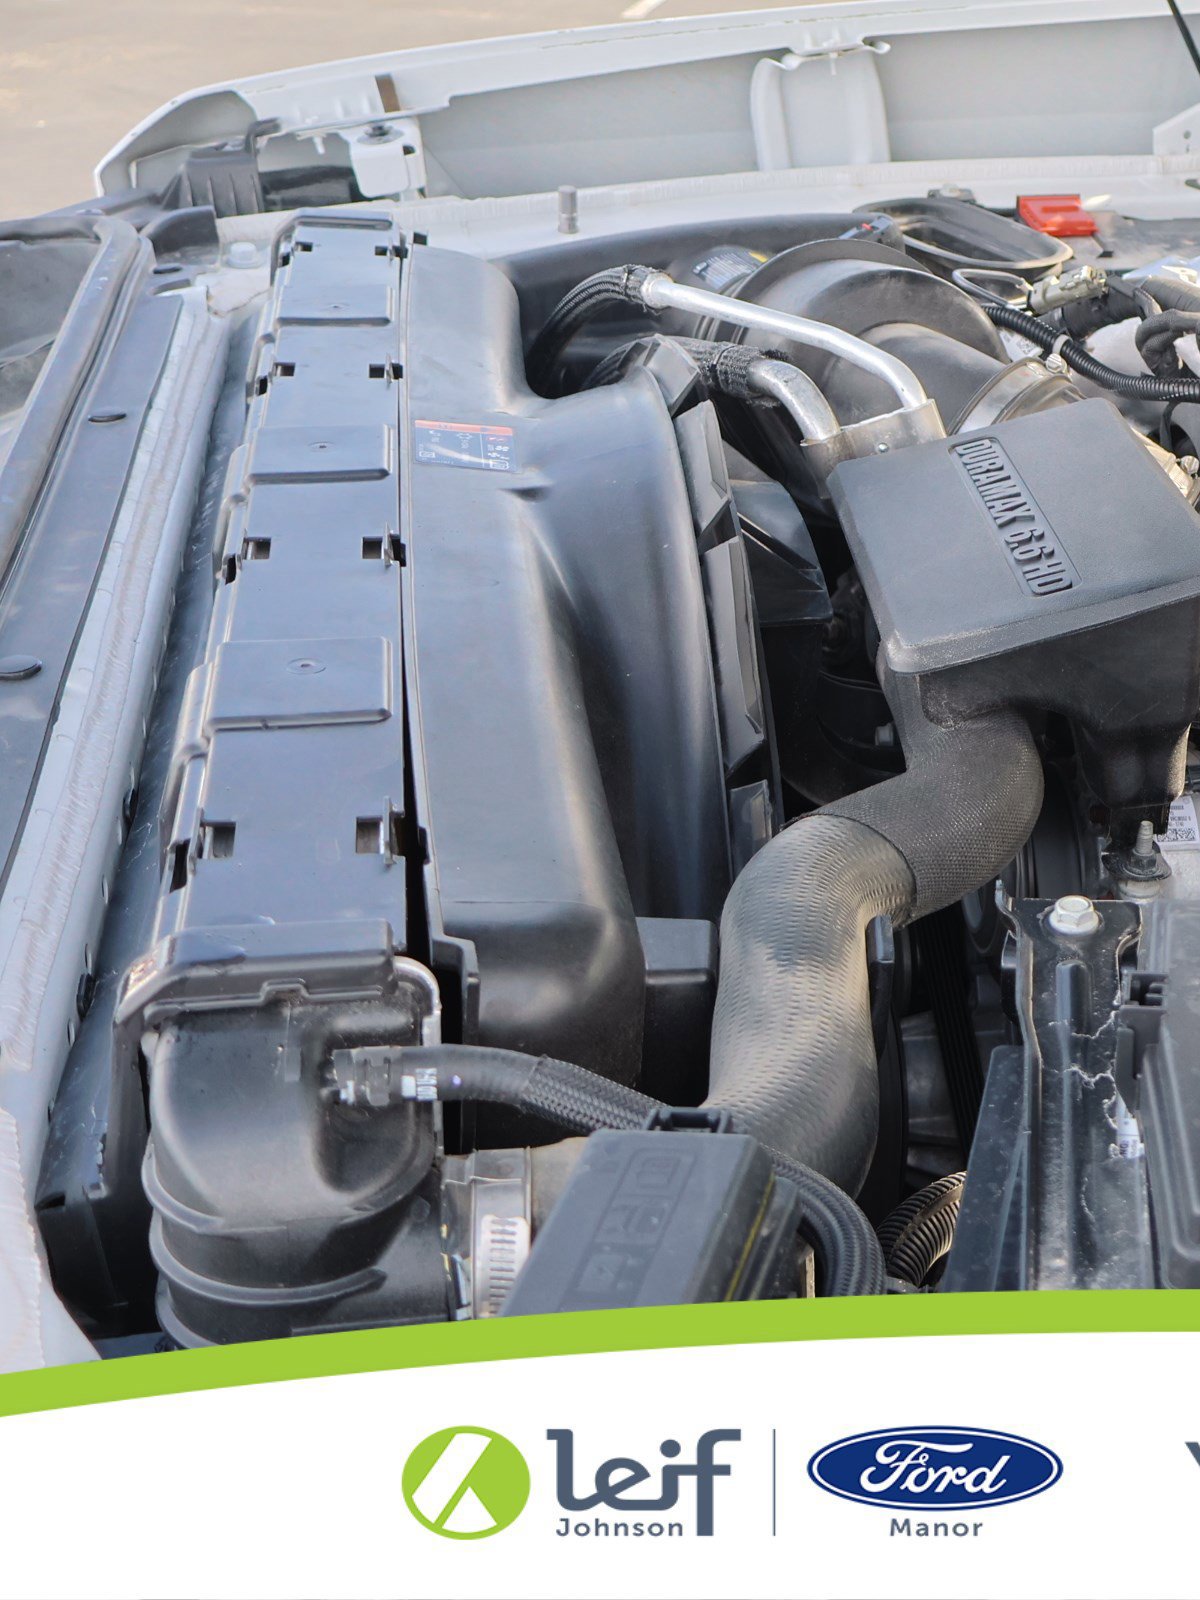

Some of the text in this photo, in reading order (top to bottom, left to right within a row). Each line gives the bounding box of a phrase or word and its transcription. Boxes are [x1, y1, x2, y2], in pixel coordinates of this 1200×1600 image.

[955, 439, 1073, 595] DURAMAX 6.6 HD
